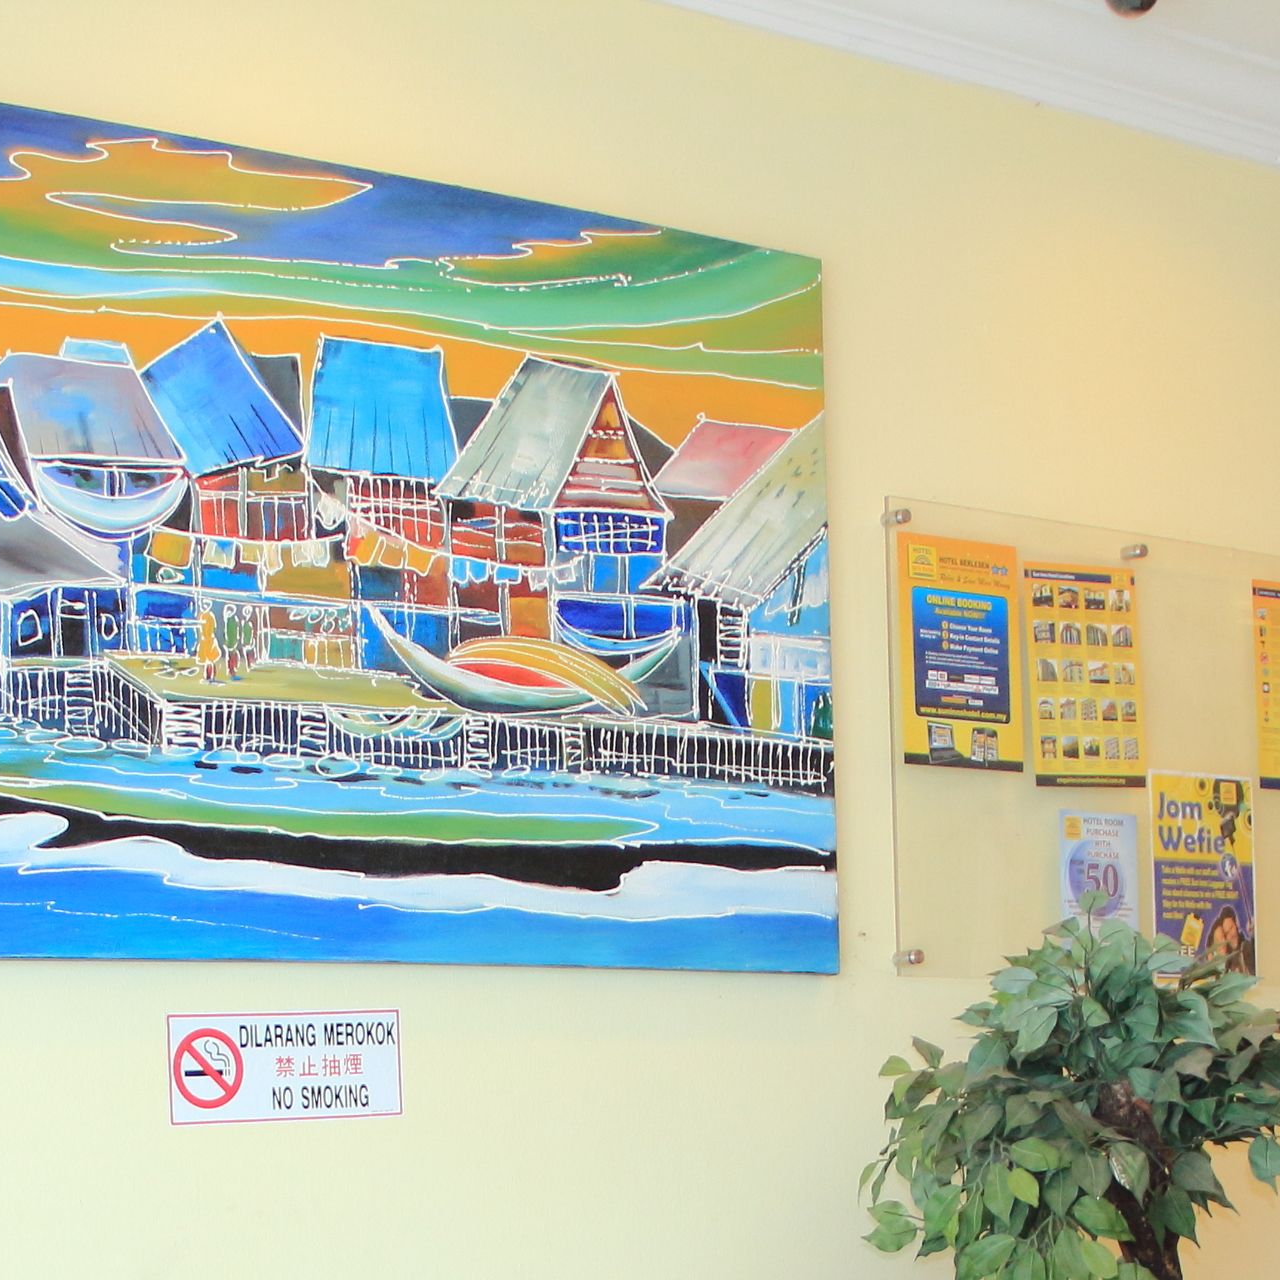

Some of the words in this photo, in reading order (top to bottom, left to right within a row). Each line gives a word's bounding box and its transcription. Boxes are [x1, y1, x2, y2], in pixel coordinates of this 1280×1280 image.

[939, 557, 958, 566] HOTEL
[926, 594, 956, 607] ONLINE
[957, 597, 992, 611] BOOKING
[950, 622, 967, 632] Choose
[1158, 792, 1202, 821] Jom
[1084, 818, 1102, 826] HOTEL
[1104, 819, 1124, 827] ROOM
[1086, 828, 1119, 837] PURCHASE
[1158, 825, 1226, 854] Wefie
[1094, 840, 1111, 848] WITH
[1087, 851, 1120, 860] PURCHASE
[1086, 862, 1119, 898] 50
[239, 1023, 316, 1048] DILARANG
[323, 1021, 396, 1046] MEROKOK
[275, 1053, 364, 1078] 禁止抽煙
[272, 1086, 294, 1110] NO
[301, 1083, 369, 1109] SMOKING
